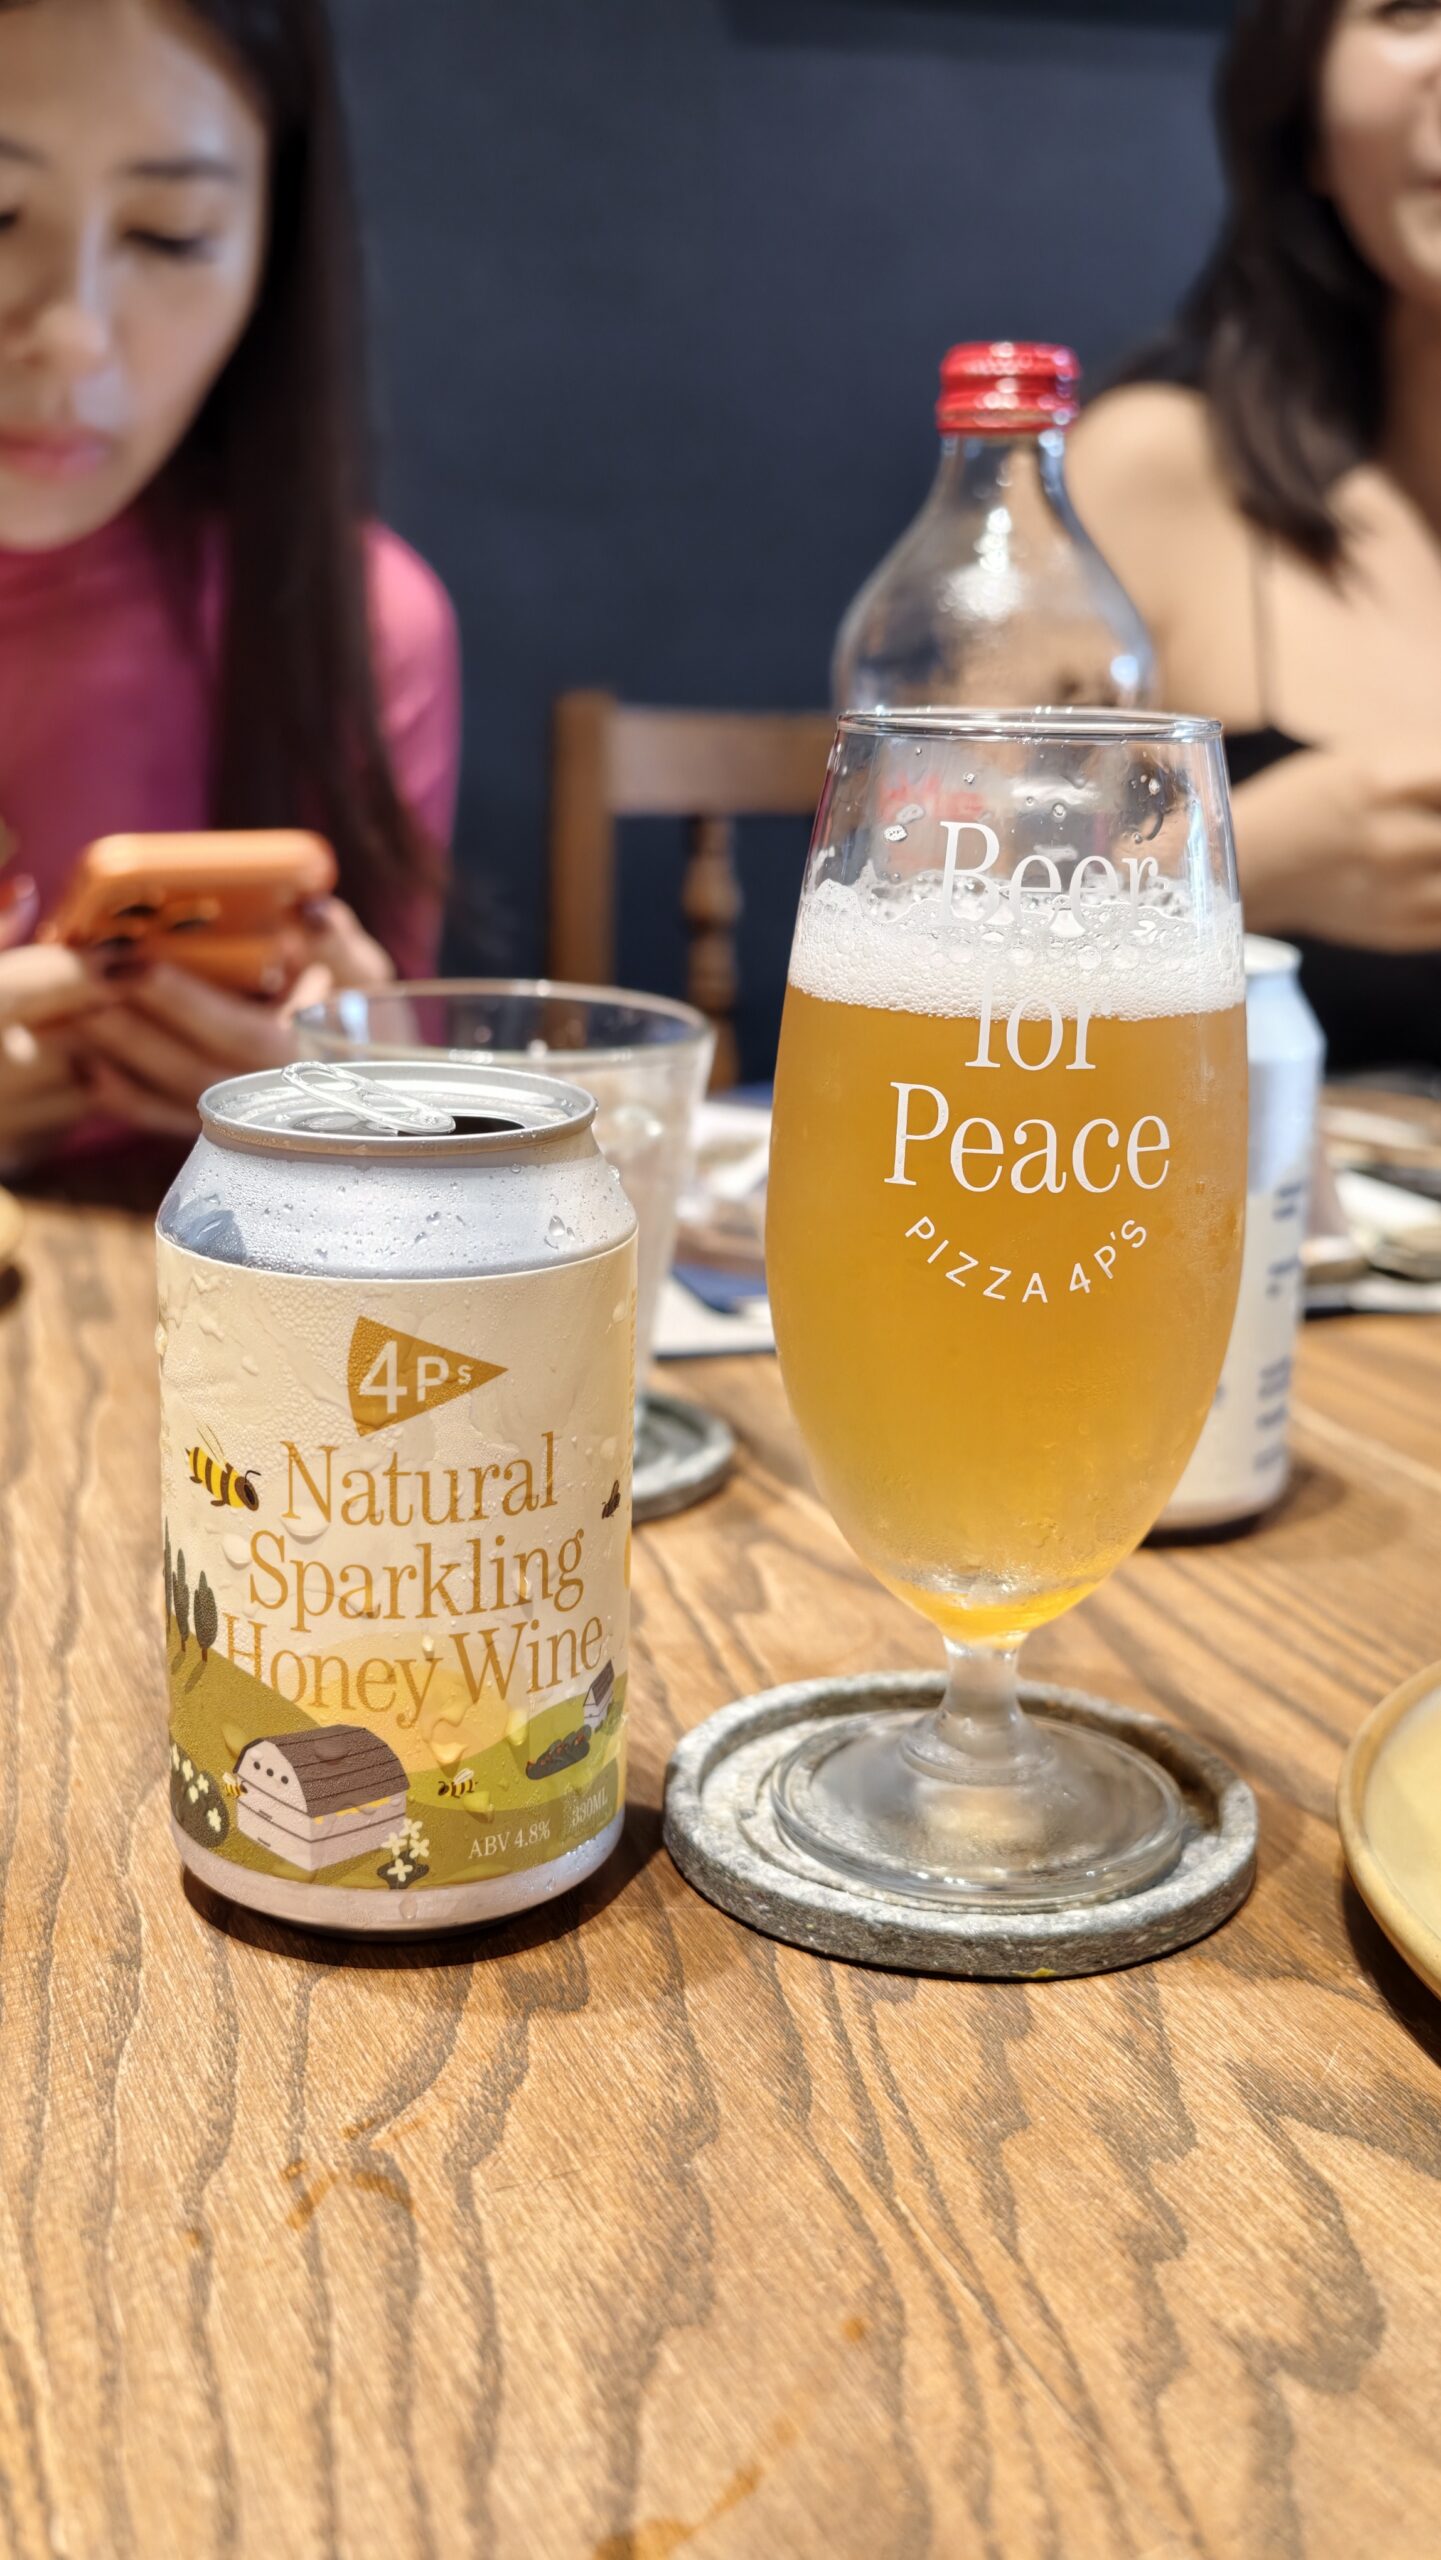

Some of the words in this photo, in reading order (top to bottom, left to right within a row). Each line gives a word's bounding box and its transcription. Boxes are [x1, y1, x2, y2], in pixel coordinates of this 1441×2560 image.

[939, 821, 1160, 930] Beer
[884, 1081, 1171, 1195] Peace
[904, 1215, 1049, 1304] PIZZA
[1068, 1218, 1148, 1294] 4P'S
[279, 1430, 558, 1528] Natural
[249, 1528, 586, 1633] Sparkling
[223, 1611, 444, 1730] Honey
[449, 1614, 604, 1705] Wine
[468, 1831, 511, 1860] ABV
[514, 1818, 551, 1849] 4.8%
